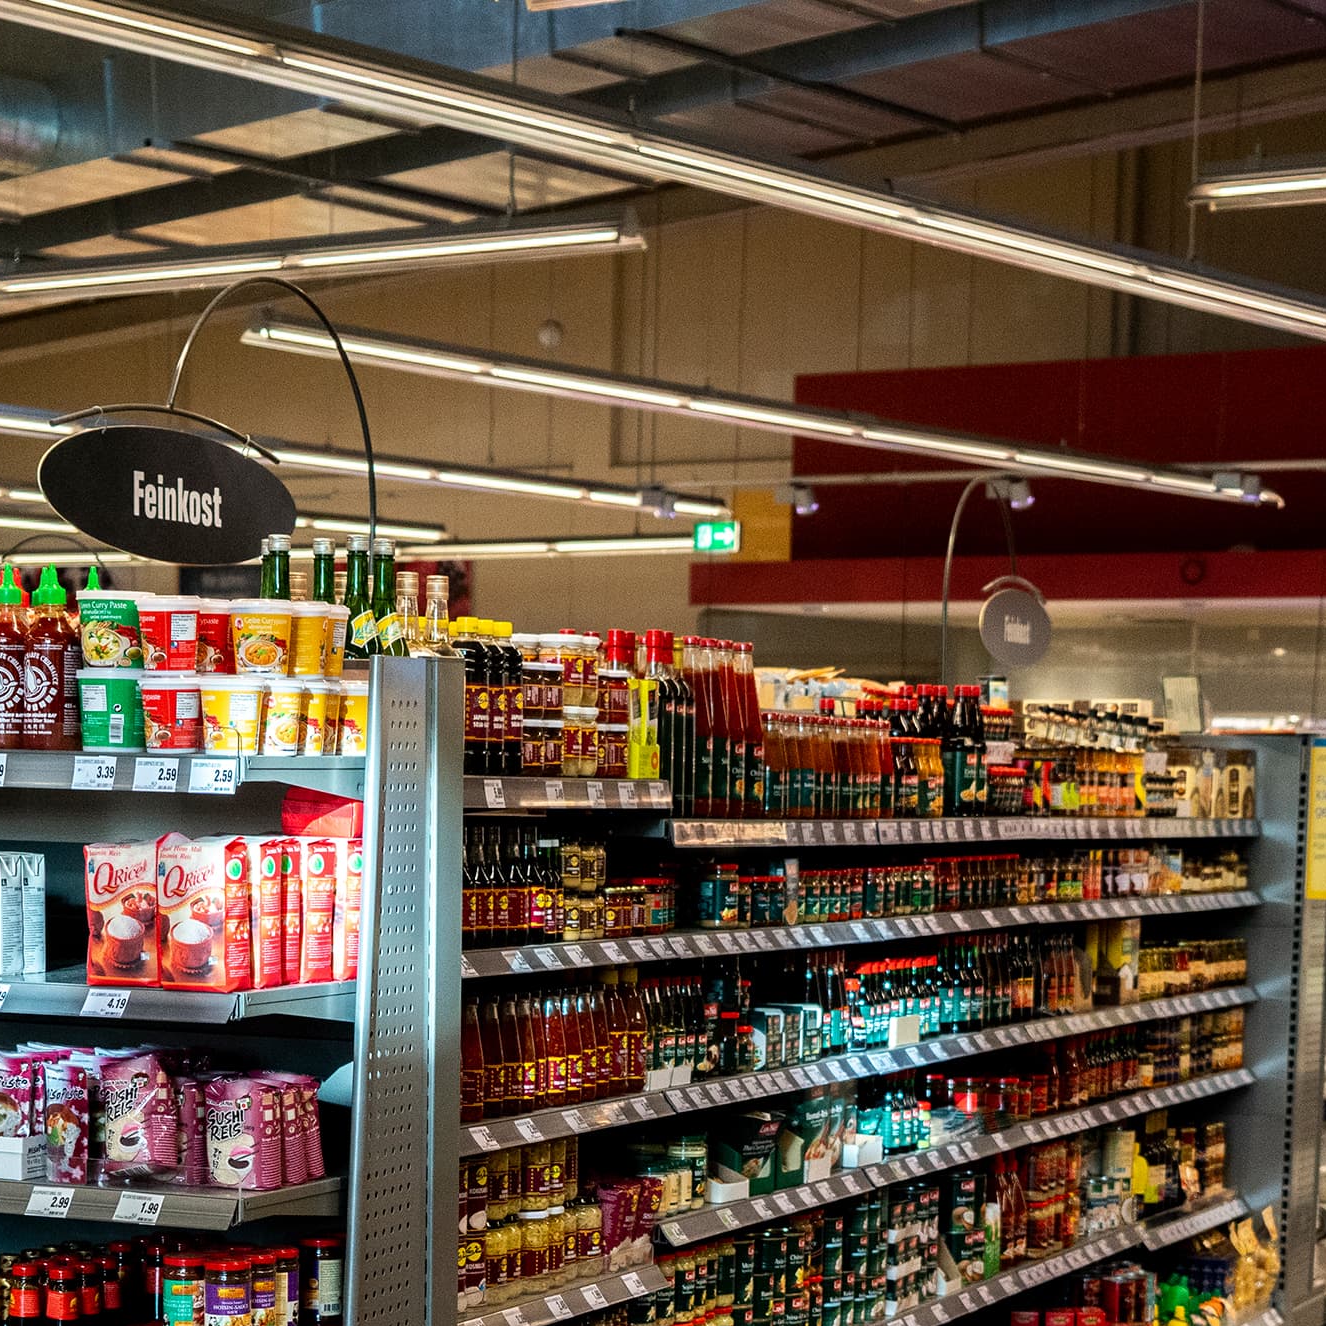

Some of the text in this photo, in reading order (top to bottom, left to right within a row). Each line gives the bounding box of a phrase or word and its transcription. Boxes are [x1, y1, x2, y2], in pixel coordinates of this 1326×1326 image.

[133, 470, 223, 528] Feinkost
[91, 601, 127, 611] Curry Paste
[97, 766, 114, 779] 3.39
[158, 769, 176, 781] 2.59
[214, 770, 232, 783] 2.59
[107, 999, 126, 1010] 4.19
[103, 1086, 139, 1106] SUSHI
[105, 1101, 134, 1122] REIS
[207, 1109, 245, 1128] SUSHI
[211, 1123, 243, 1141] REIS
[51, 1197, 70, 1208] 2.99
[141, 1203, 159, 1214] 1.99
